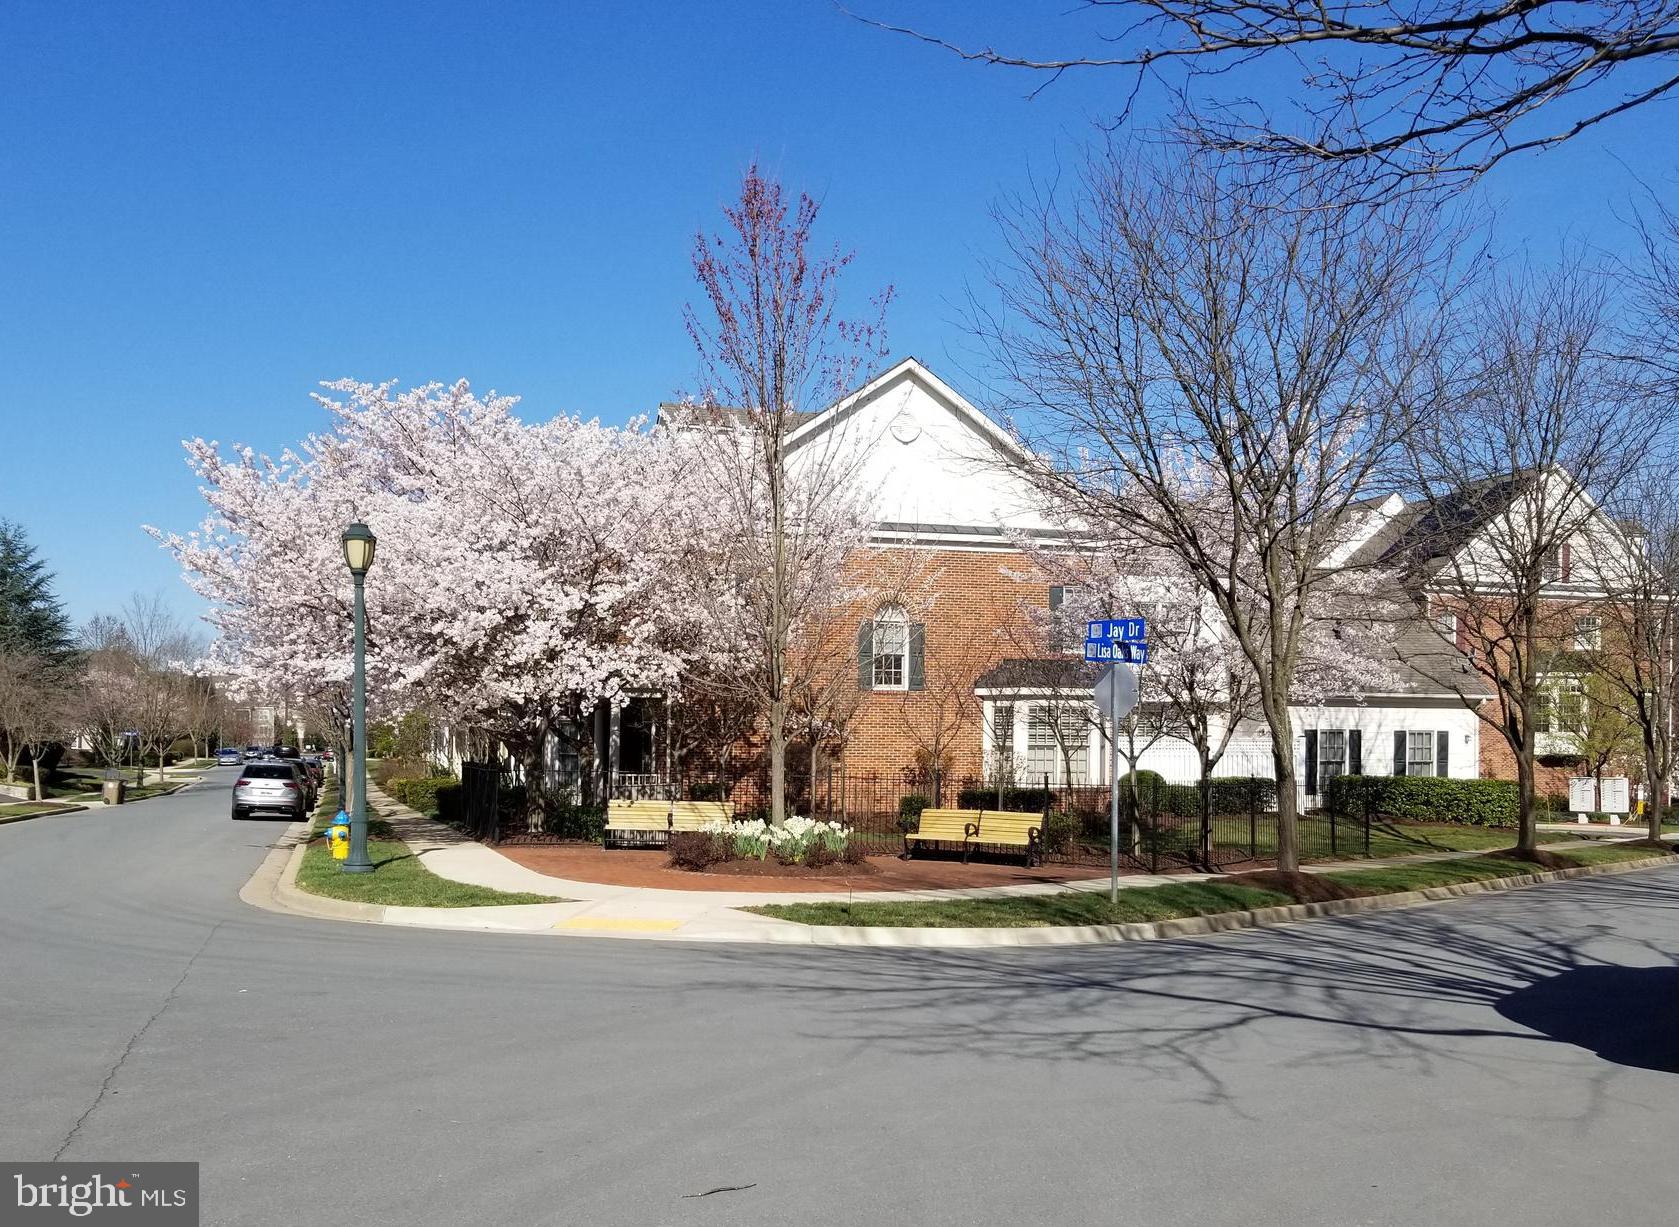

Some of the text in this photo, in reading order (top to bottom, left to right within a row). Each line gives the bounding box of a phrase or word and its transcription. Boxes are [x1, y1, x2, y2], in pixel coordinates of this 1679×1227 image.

[1107, 622, 1139, 641] Jay Dr
[1097, 643, 1110, 658] Lisa
[1131, 645, 1145, 665] Way
